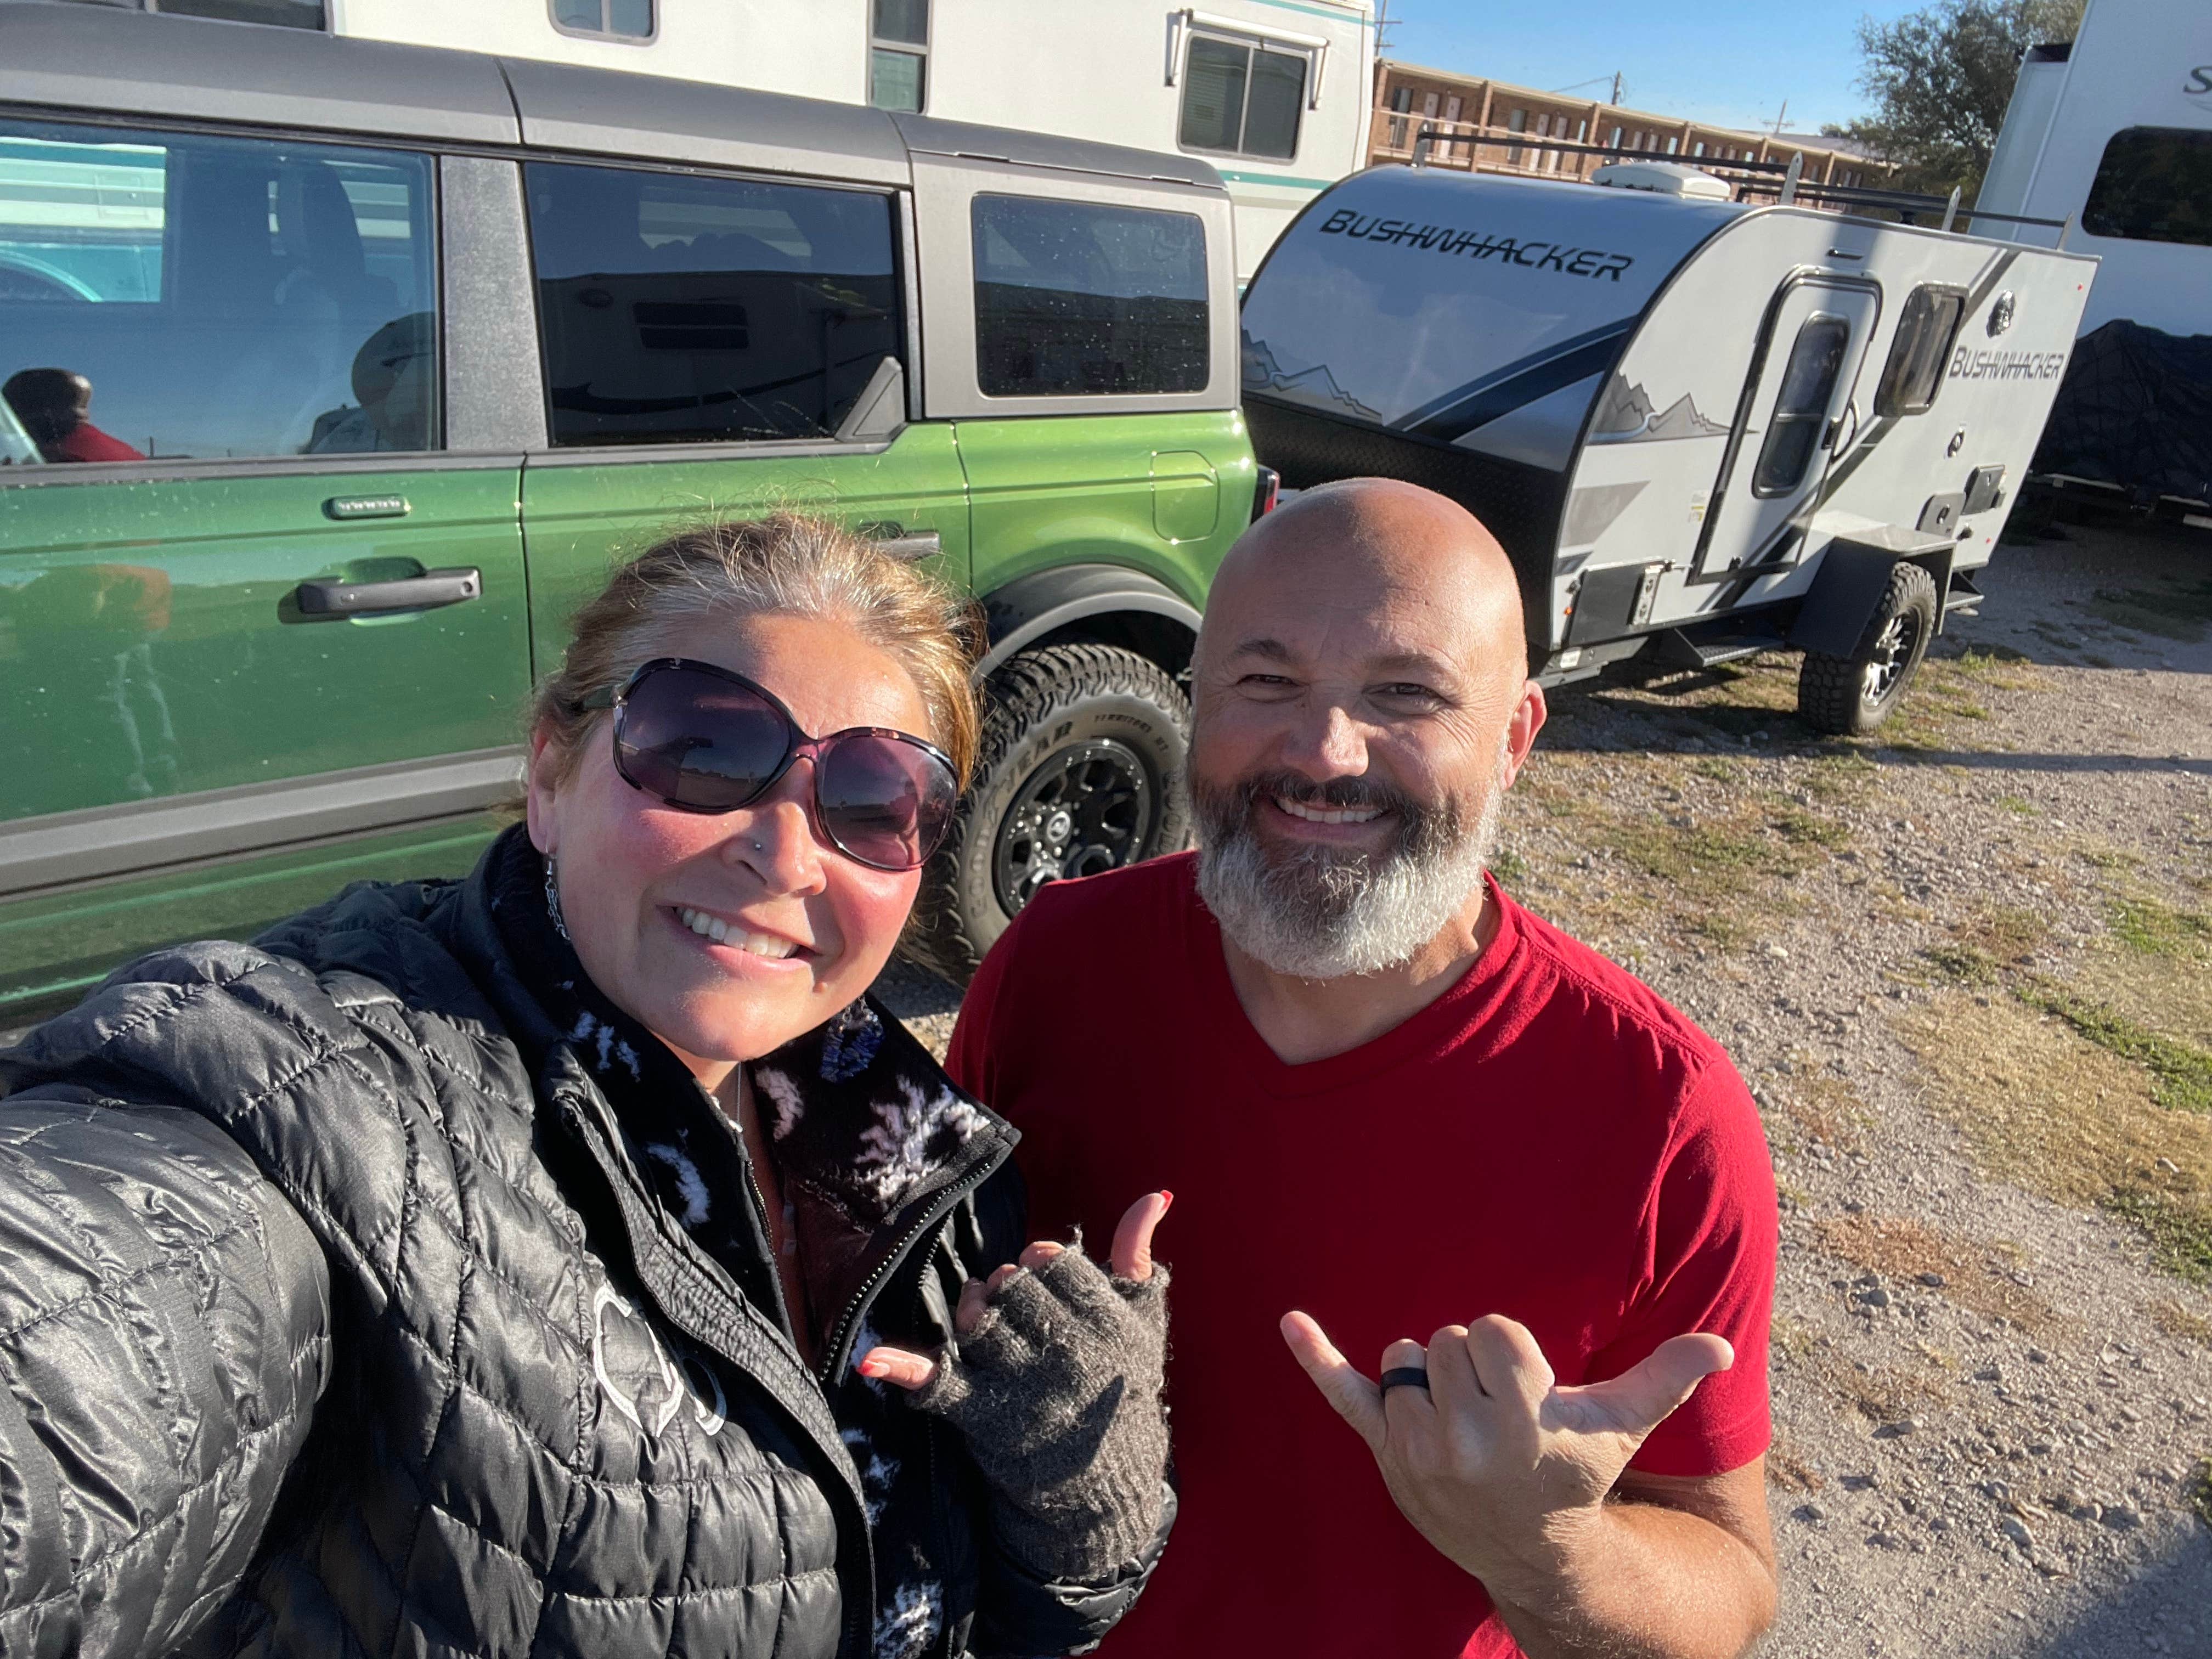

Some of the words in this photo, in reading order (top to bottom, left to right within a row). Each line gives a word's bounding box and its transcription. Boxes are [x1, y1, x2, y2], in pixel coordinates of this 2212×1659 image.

[1318, 208, 1635, 283] BUSHWHACKER
[1948, 346, 2064, 380] BUSHWHACKER
[970, 720, 1073, 918] GOODYEAR
